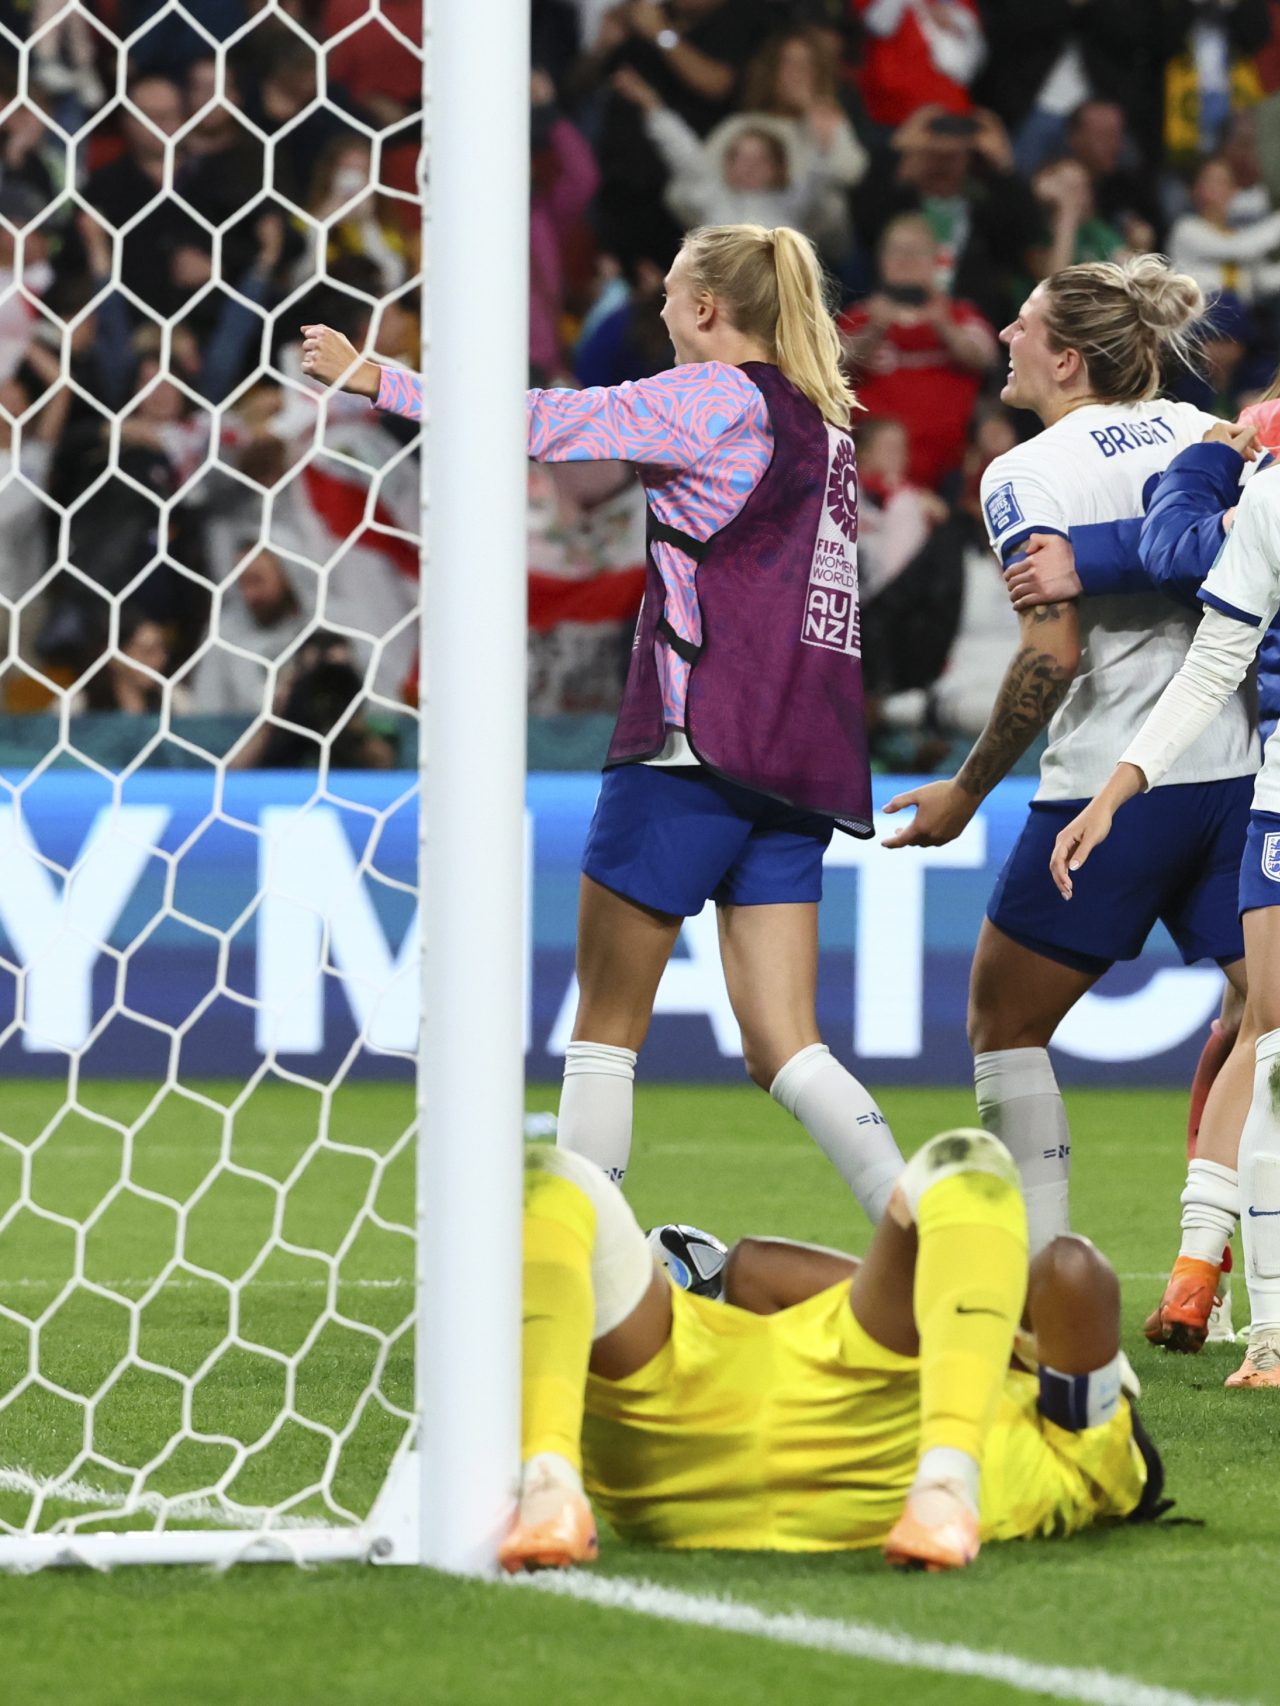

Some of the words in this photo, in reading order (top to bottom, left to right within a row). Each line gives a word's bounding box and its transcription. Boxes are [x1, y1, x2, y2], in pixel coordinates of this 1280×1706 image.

[816, 538, 846, 558] FIFA
[813, 566, 855, 588] WORLD
[808, 590, 849, 619] AU
[805, 616, 846, 646] NZ
